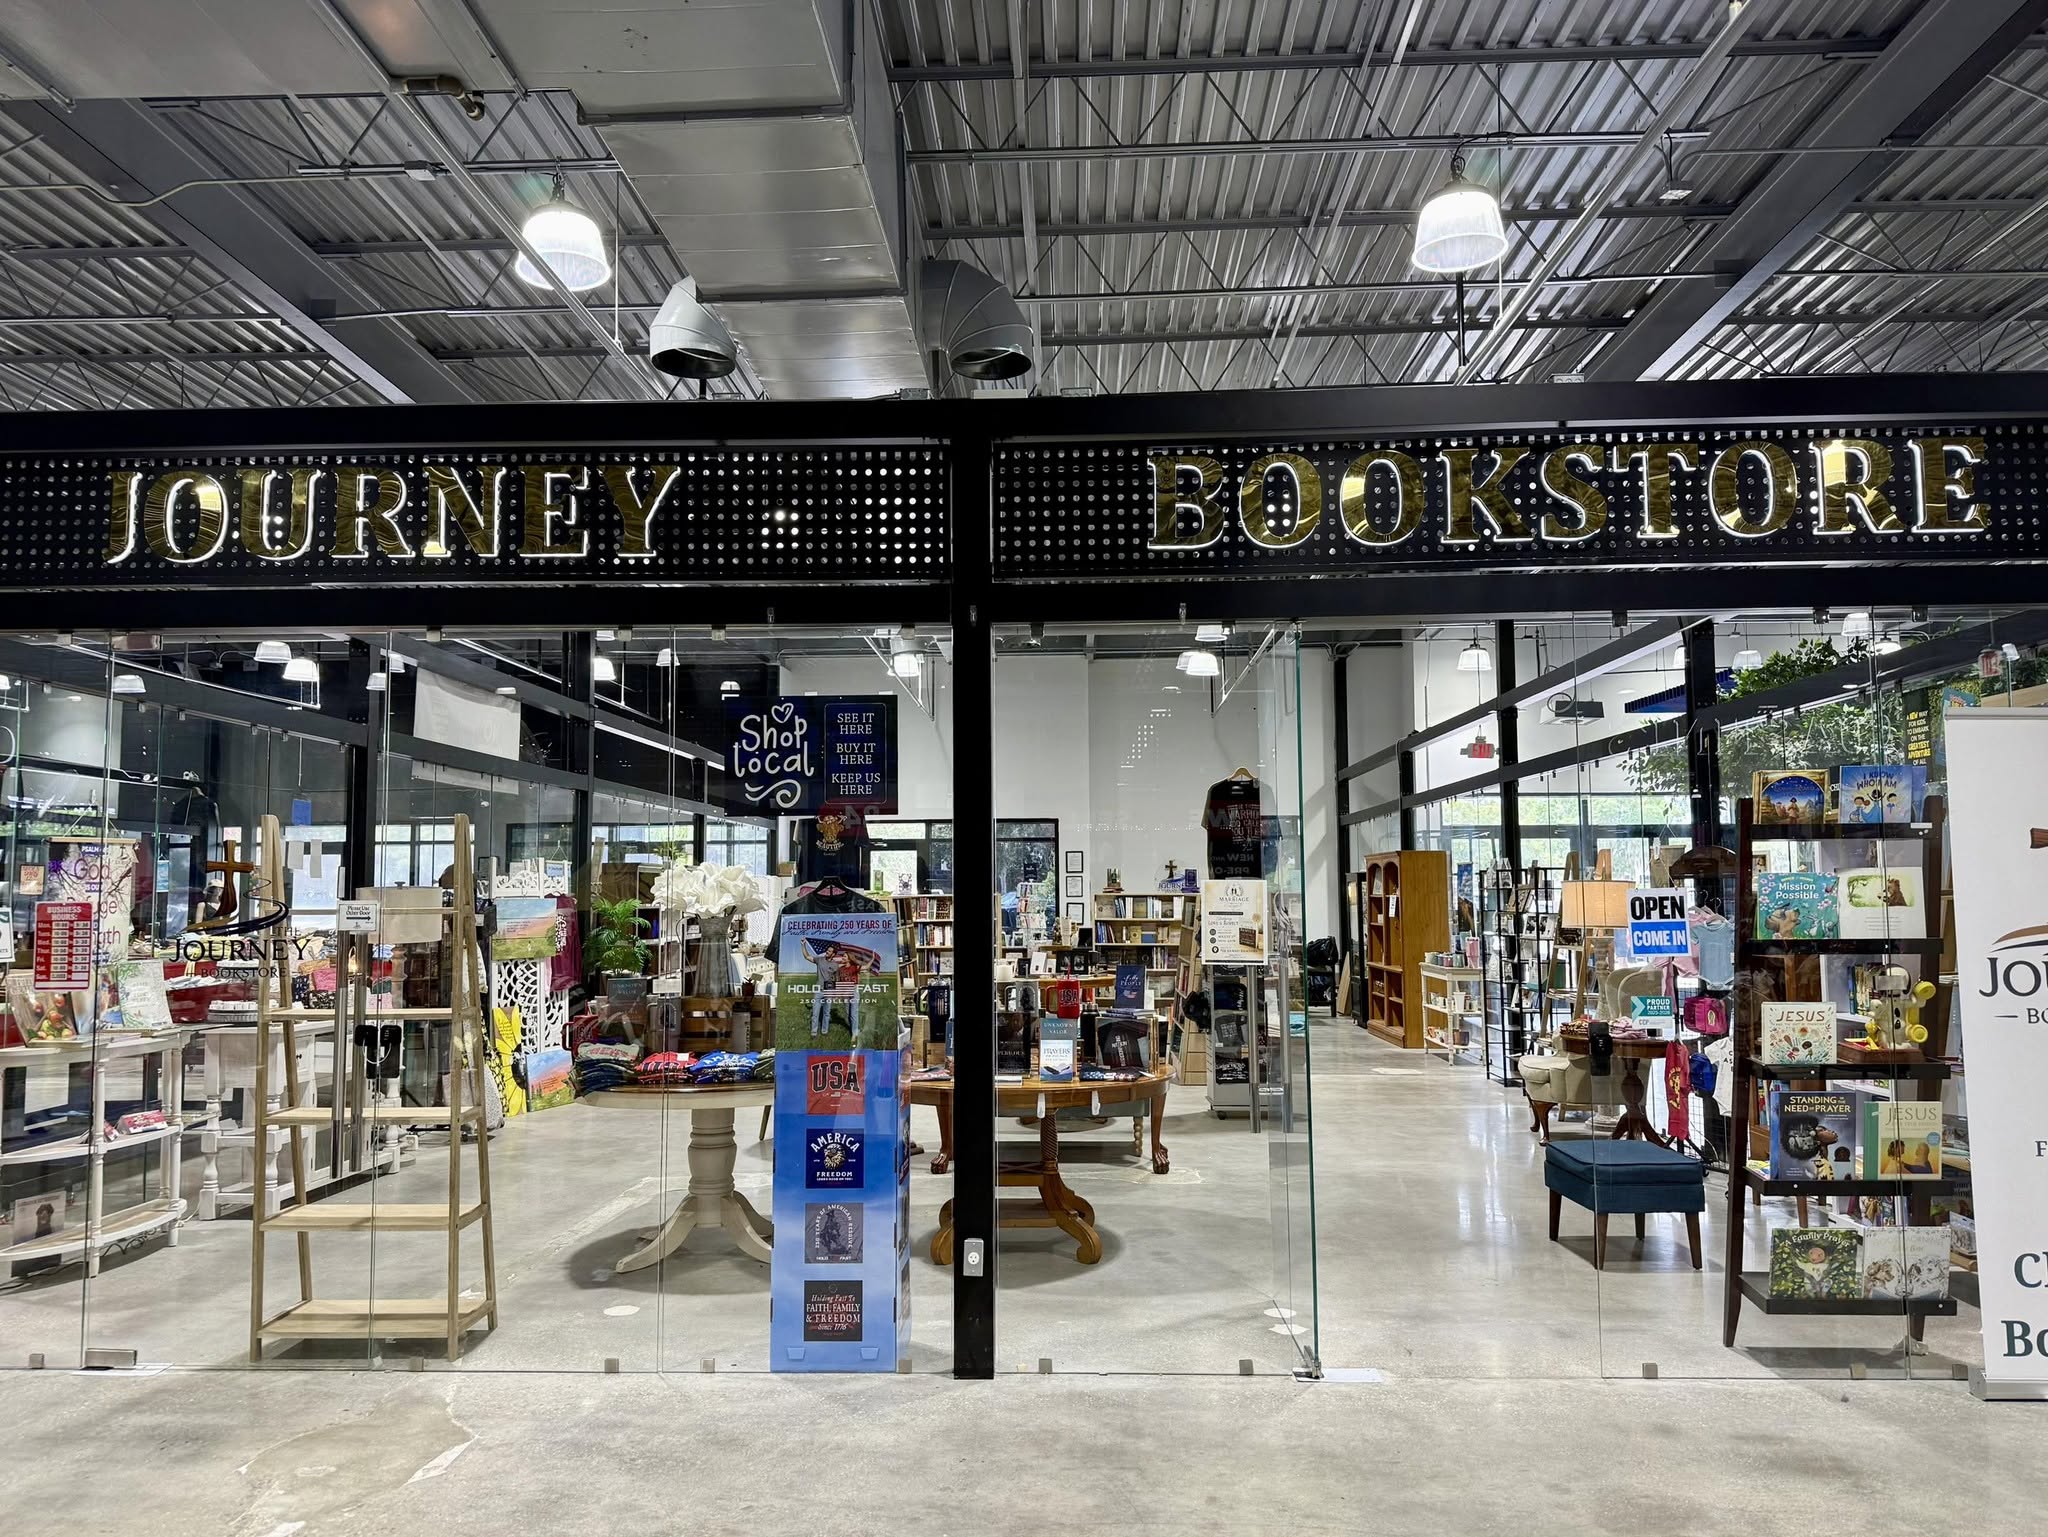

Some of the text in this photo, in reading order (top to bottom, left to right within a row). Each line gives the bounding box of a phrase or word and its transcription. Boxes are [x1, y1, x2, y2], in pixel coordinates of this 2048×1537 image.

[1146, 437, 1990, 552] BOOKSTORE
[102, 467, 681, 564] JOURNEY
[837, 713, 875, 723] SEE IT
[740, 714, 807, 751] Shop
[840, 725, 872, 735] HERE
[836, 743, 876, 753] BUY IT
[840, 755, 872, 765] HERE
[832, 773, 881, 783] KEEP US
[840, 784, 872, 795] HERE
[1857, 779, 1876, 791] WHO
[74, 858, 111, 880] God
[1778, 882, 1816, 890] Mission
[1776, 891, 1820, 900] Possible
[1630, 896, 1685, 920] OPEN
[788, 920, 892, 930] CELEBRATING 250 YEARS OF
[1633, 929, 1686, 946] COME IN
[169, 939, 311, 962] JOURNEY
[201, 968, 288, 978] BOOKSTORE
[788, 984, 889, 994] HOLD FAST
[1059, 989, 1078, 1003] USA
[1776, 1010, 1826, 1022] JESUS
[811, 1061, 861, 1094] USA
[1790, 1096, 1837, 1104] STANDING
[1886, 1108, 1937, 1126] JESUS
[810, 1132, 860, 1152] AMERICA
[828, 1204, 852, 1221] AMERICAN
[1792, 1232, 1822, 1243] Family
[1823, 1232, 1852, 1247] Prayer
[811, 1294, 834, 1304] Holding
[832, 1304, 860, 1312] FAMILY
[806, 1314, 860, 1323] & FREEDOM
